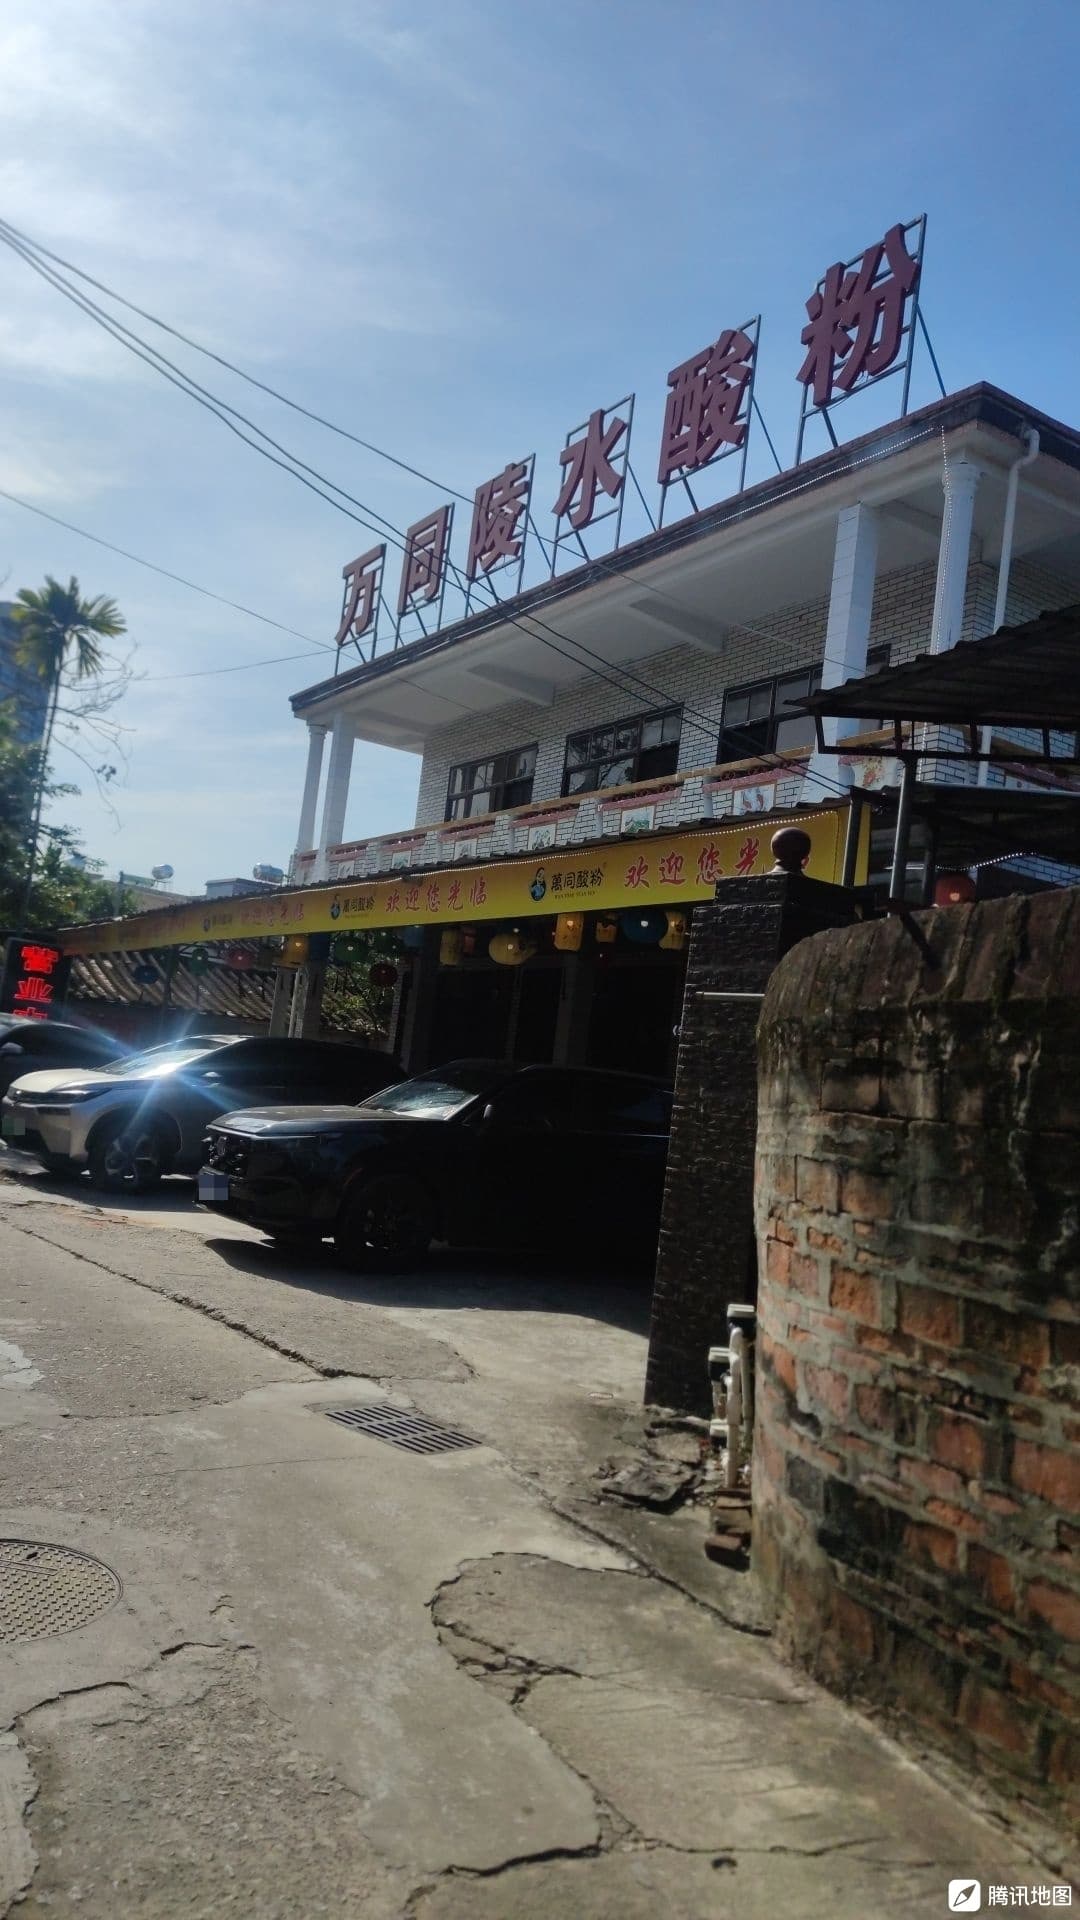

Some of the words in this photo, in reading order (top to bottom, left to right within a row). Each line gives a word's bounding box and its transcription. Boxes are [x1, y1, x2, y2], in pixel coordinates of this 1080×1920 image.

[335, 223, 919, 646] 万同陵水酸粉
[624, 837, 810, 888] 欢迎您光
[386, 876, 488, 913] 欢迎您光临
